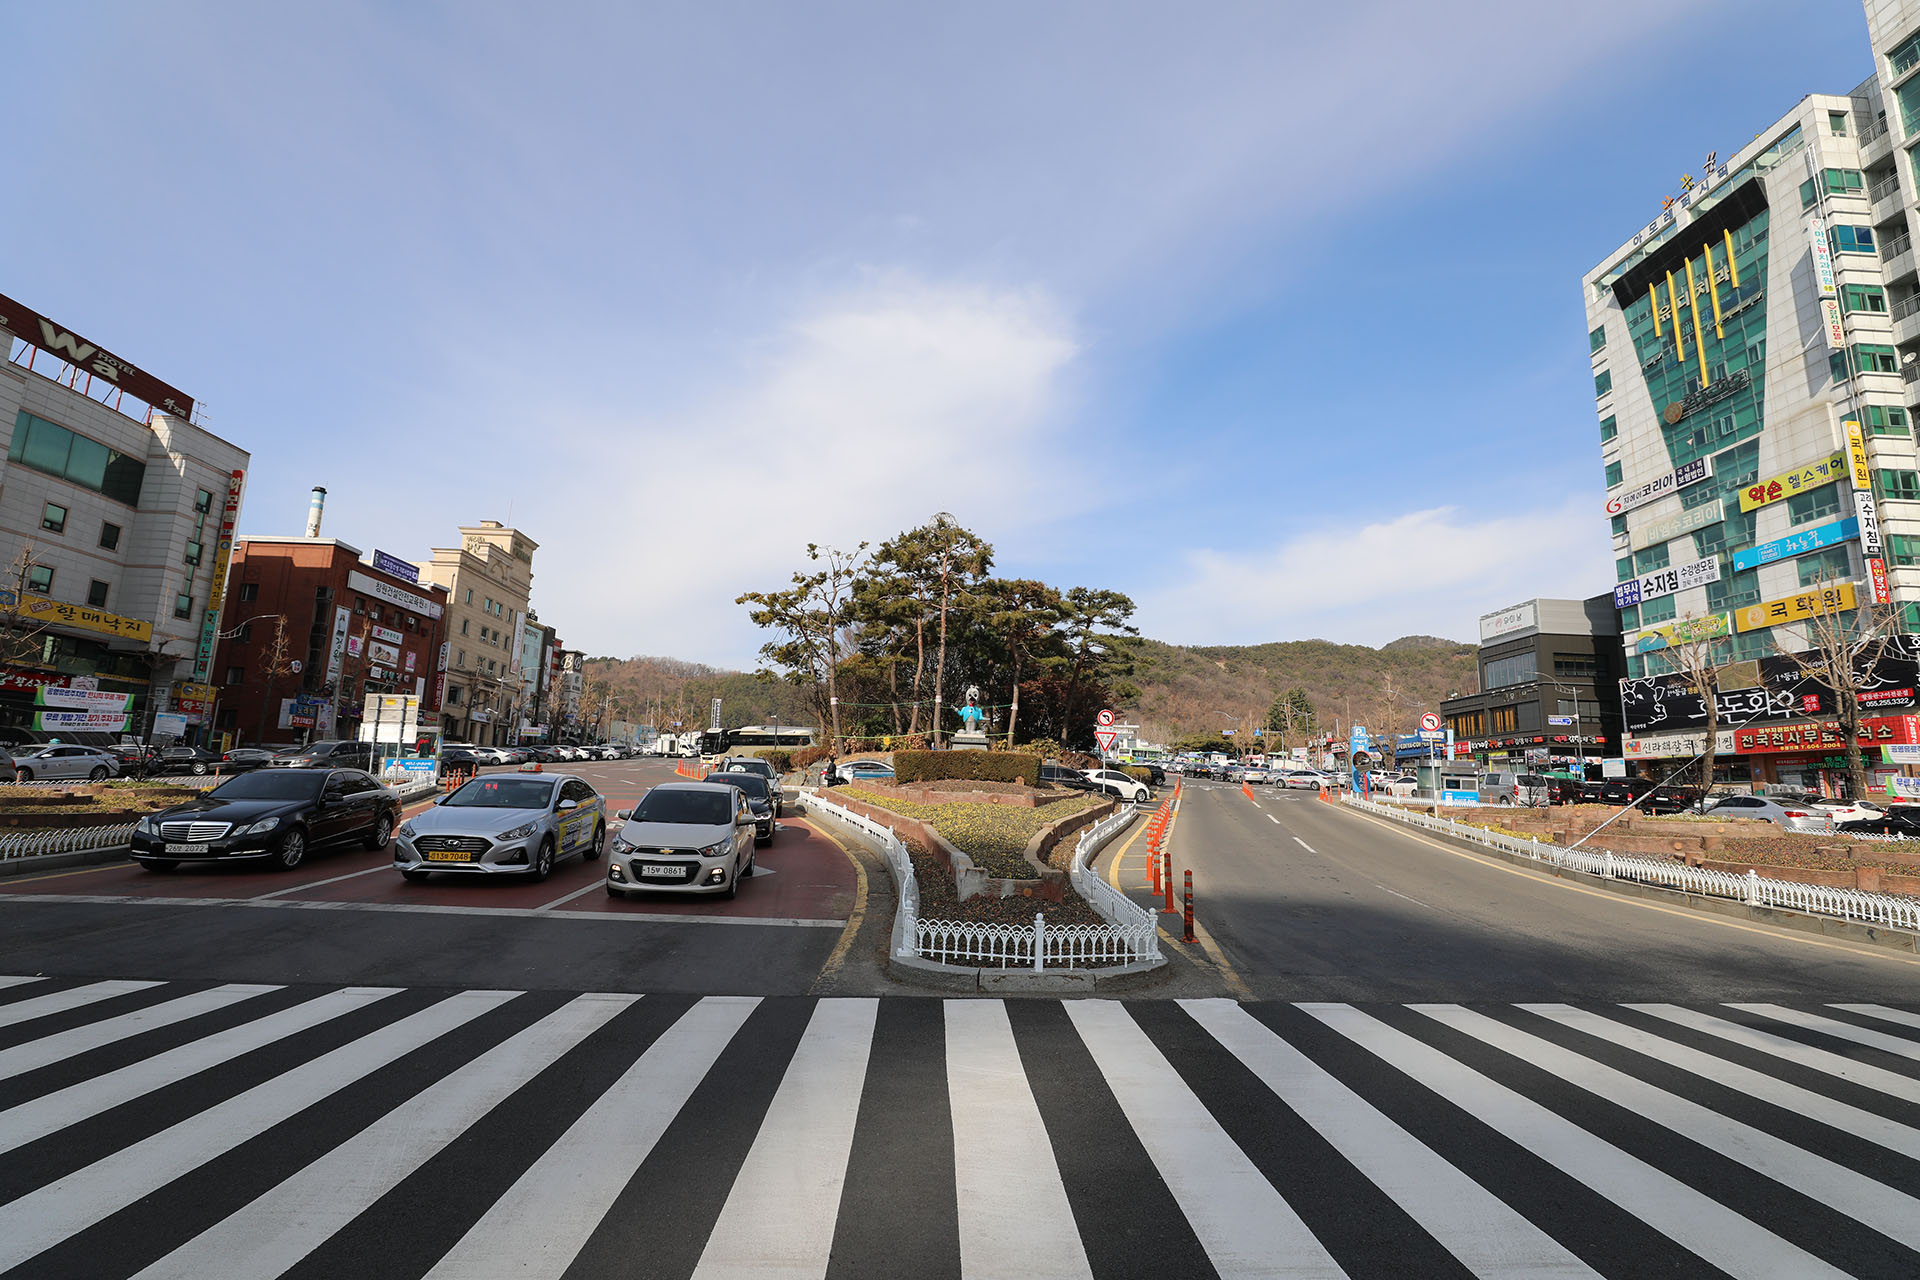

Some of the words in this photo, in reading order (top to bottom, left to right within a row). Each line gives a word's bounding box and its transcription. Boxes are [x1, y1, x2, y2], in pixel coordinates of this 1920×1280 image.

[1633, 163, 1729, 246] 아모레퍼시픽
[1658, 264, 1730, 322] 유디치과
[97, 351, 135, 377] MOTEL
[1851, 437, 1868, 482] 국학원
[1748, 479, 1783, 504] 약손
[1787, 456, 1844, 490] 헬스케어
[1862, 503, 1879, 544] 수지침
[1785, 530, 1824, 553] 하늘꿈
[1680, 558, 1715, 578] 수강생모집
[1615, 581, 1640, 599] 법무사
[1642, 569, 1680, 598] 수지침
[1770, 588, 1844, 618] 국학원
[55, 603, 141, 632] 할매낙지
[1687, 689, 1805, 722] 화돈화우
[1865, 697, 1909, 708] 055.255.3322
[45, 713, 59, 721] 무료
[60, 713, 73, 722] 개방
[74, 713, 88, 722] 기간
[1741, 724, 1895, 749] 전국천사무료식소
[450, 852, 469, 861] 7048
[663, 866, 683, 875] 0861
